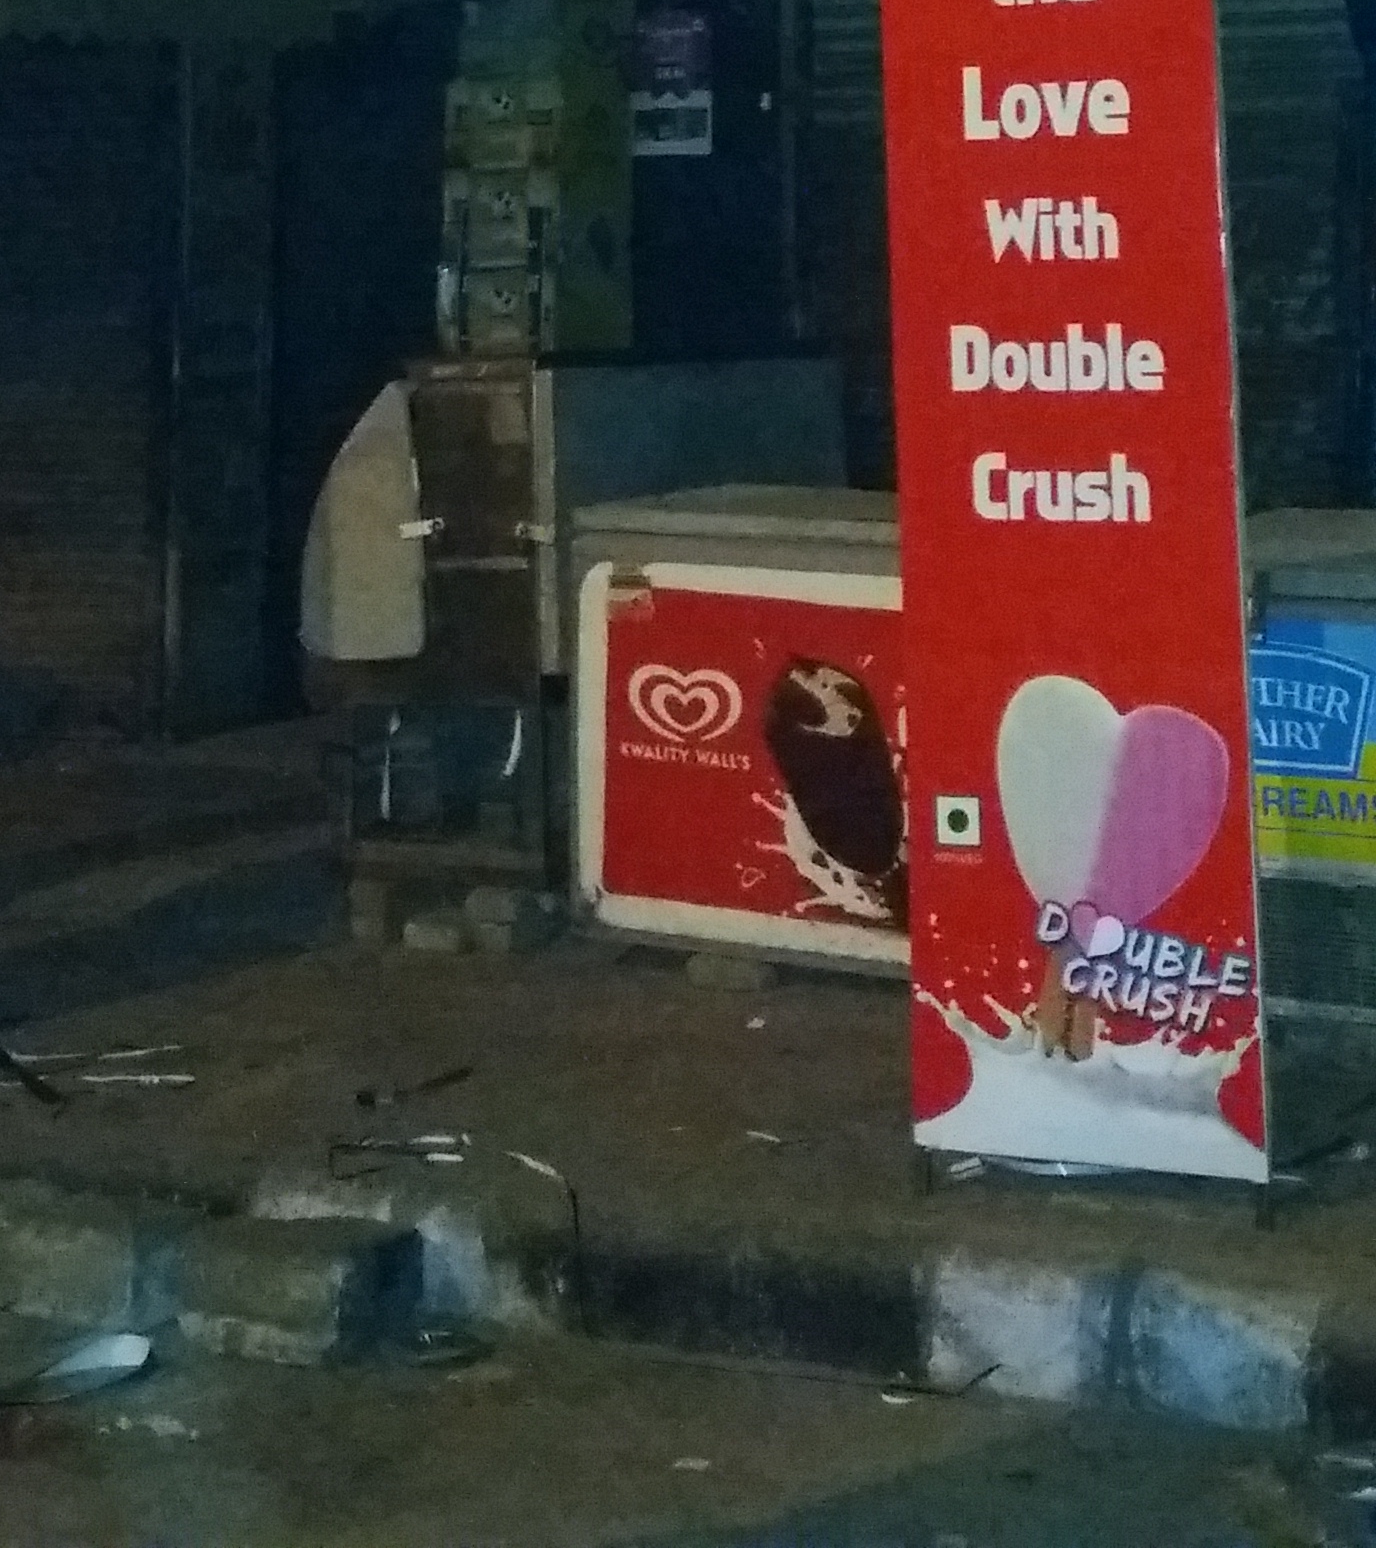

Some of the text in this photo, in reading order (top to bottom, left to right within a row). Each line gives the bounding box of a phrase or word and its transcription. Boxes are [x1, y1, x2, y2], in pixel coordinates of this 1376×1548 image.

[961, 65, 1132, 142] Love
[983, 195, 1121, 264] With
[949, 322, 1168, 393] Double
[972, 451, 1153, 523] Crush
[620, 741, 752, 772] KWALITY WALL'S
[1060, 955, 1215, 1036] CRUSH
